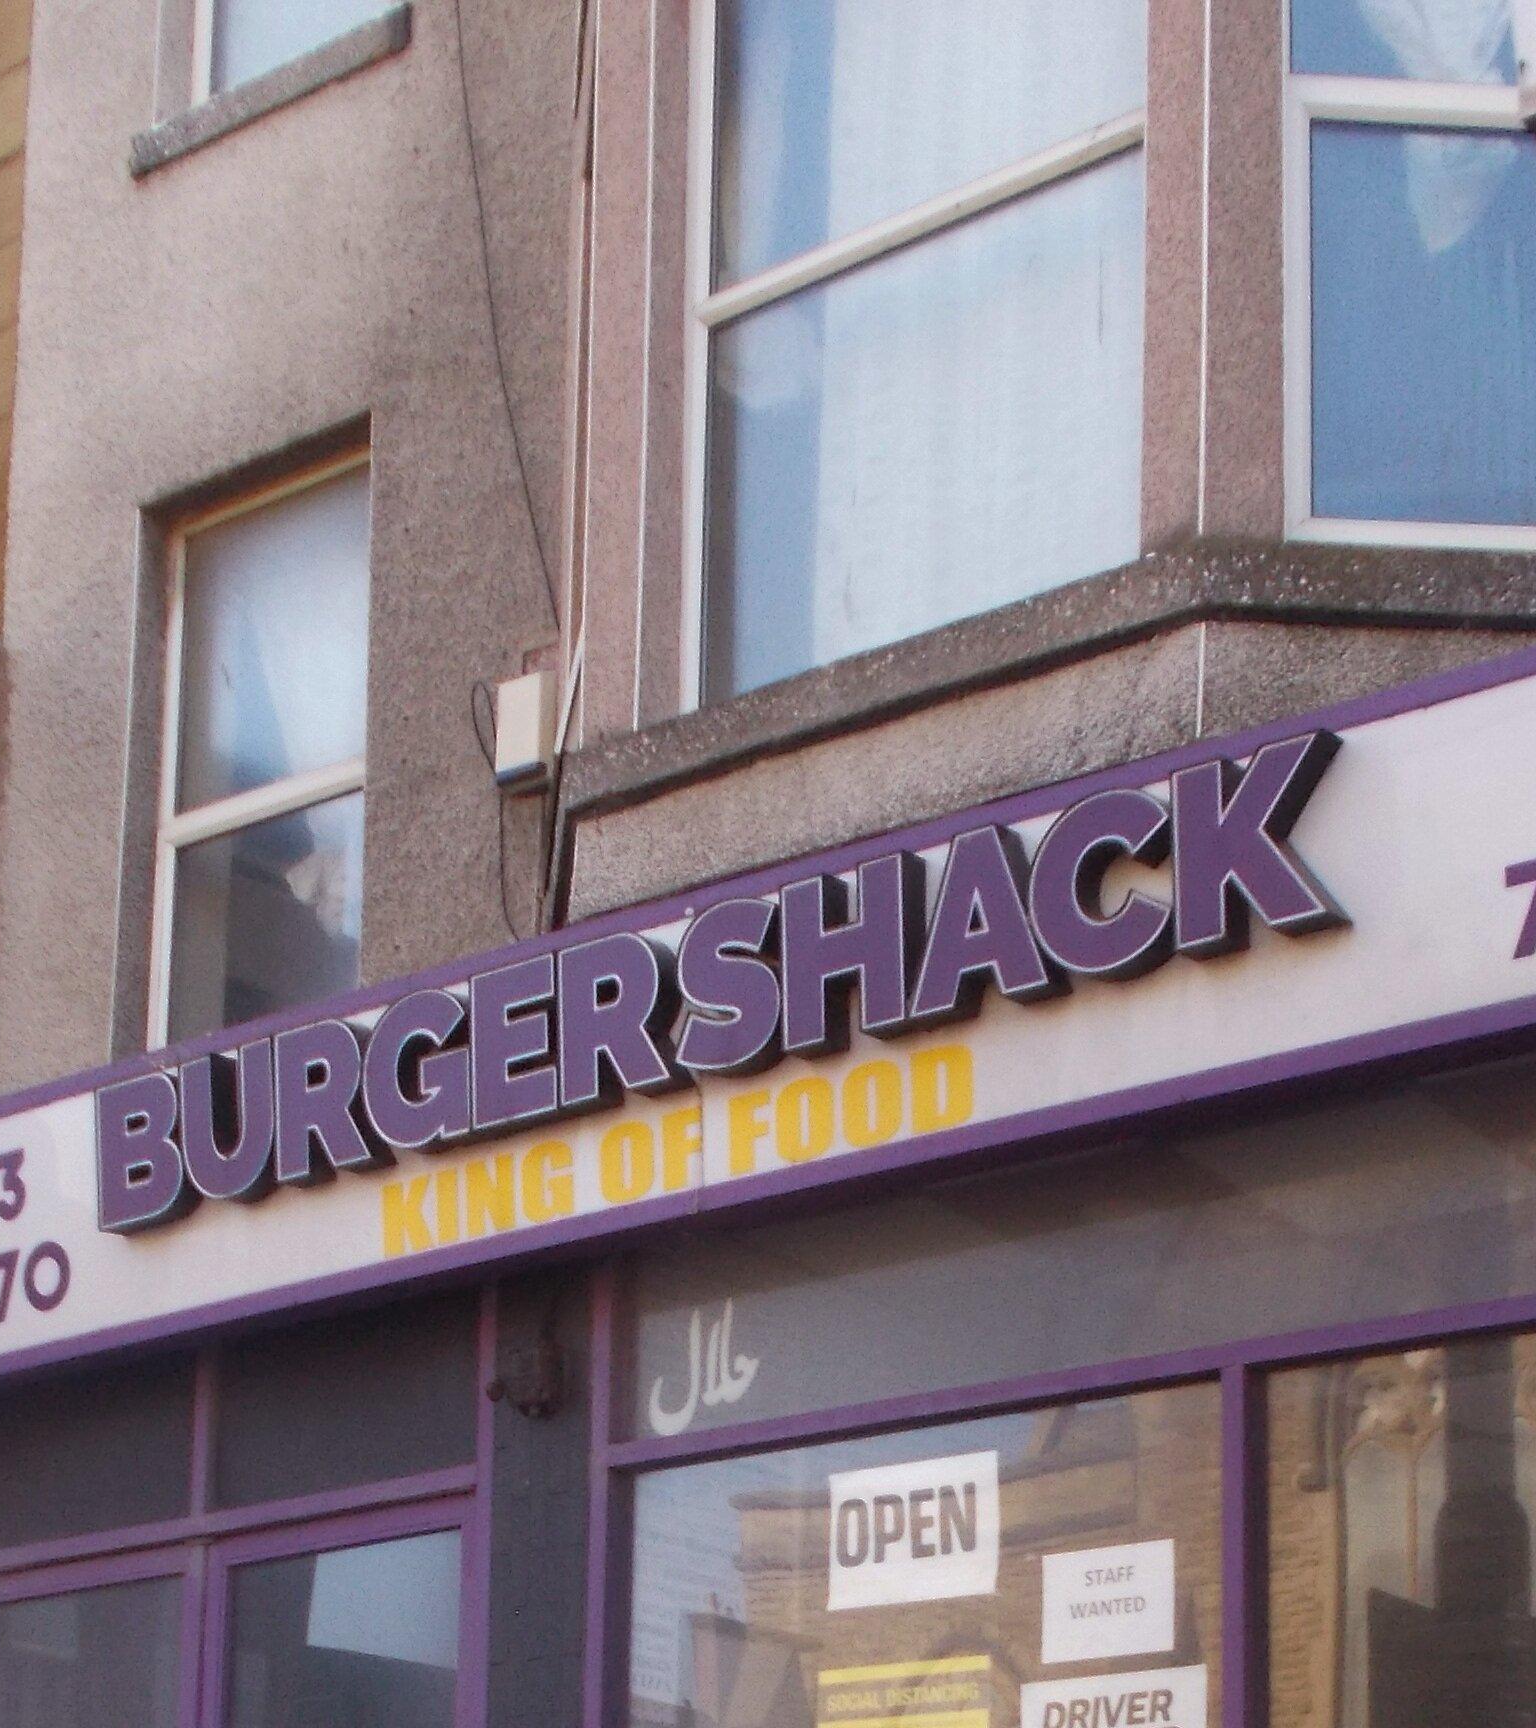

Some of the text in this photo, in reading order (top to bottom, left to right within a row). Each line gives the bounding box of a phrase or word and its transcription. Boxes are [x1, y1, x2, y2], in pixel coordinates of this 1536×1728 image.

[381, 1043, 975, 1258] KING OF FOOD
[837, 1481, 978, 1569] OPEN
[1084, 1565, 1136, 1588] STAFF
[1069, 1596, 1146, 1620] WANTED
